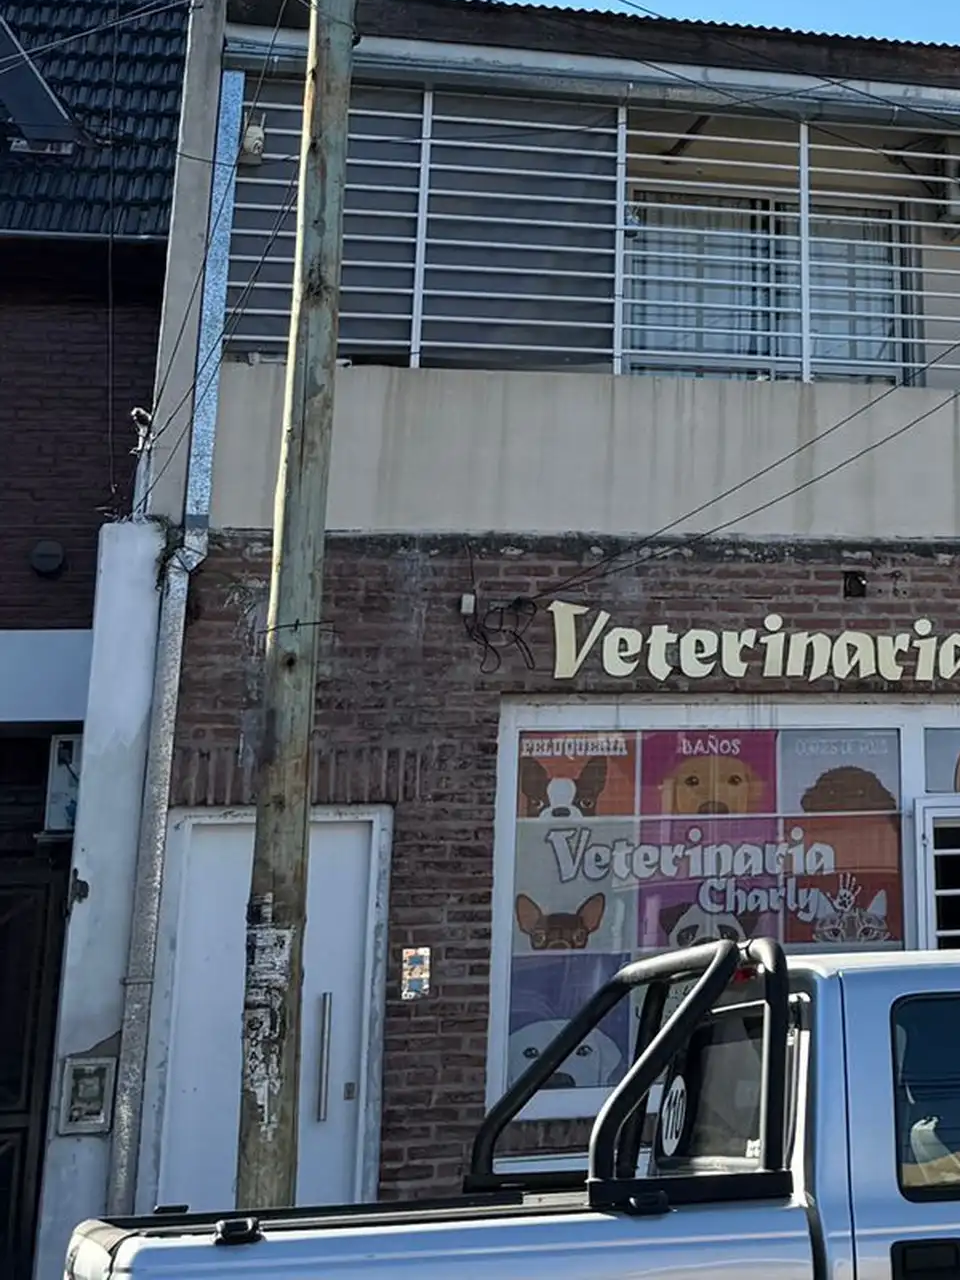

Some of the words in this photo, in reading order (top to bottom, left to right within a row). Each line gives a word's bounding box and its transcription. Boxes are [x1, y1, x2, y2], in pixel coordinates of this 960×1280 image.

[678, 733, 742, 755] BAÑOS
[546, 827, 837, 883] Veterinaria
[697, 875, 824, 923] Charly
